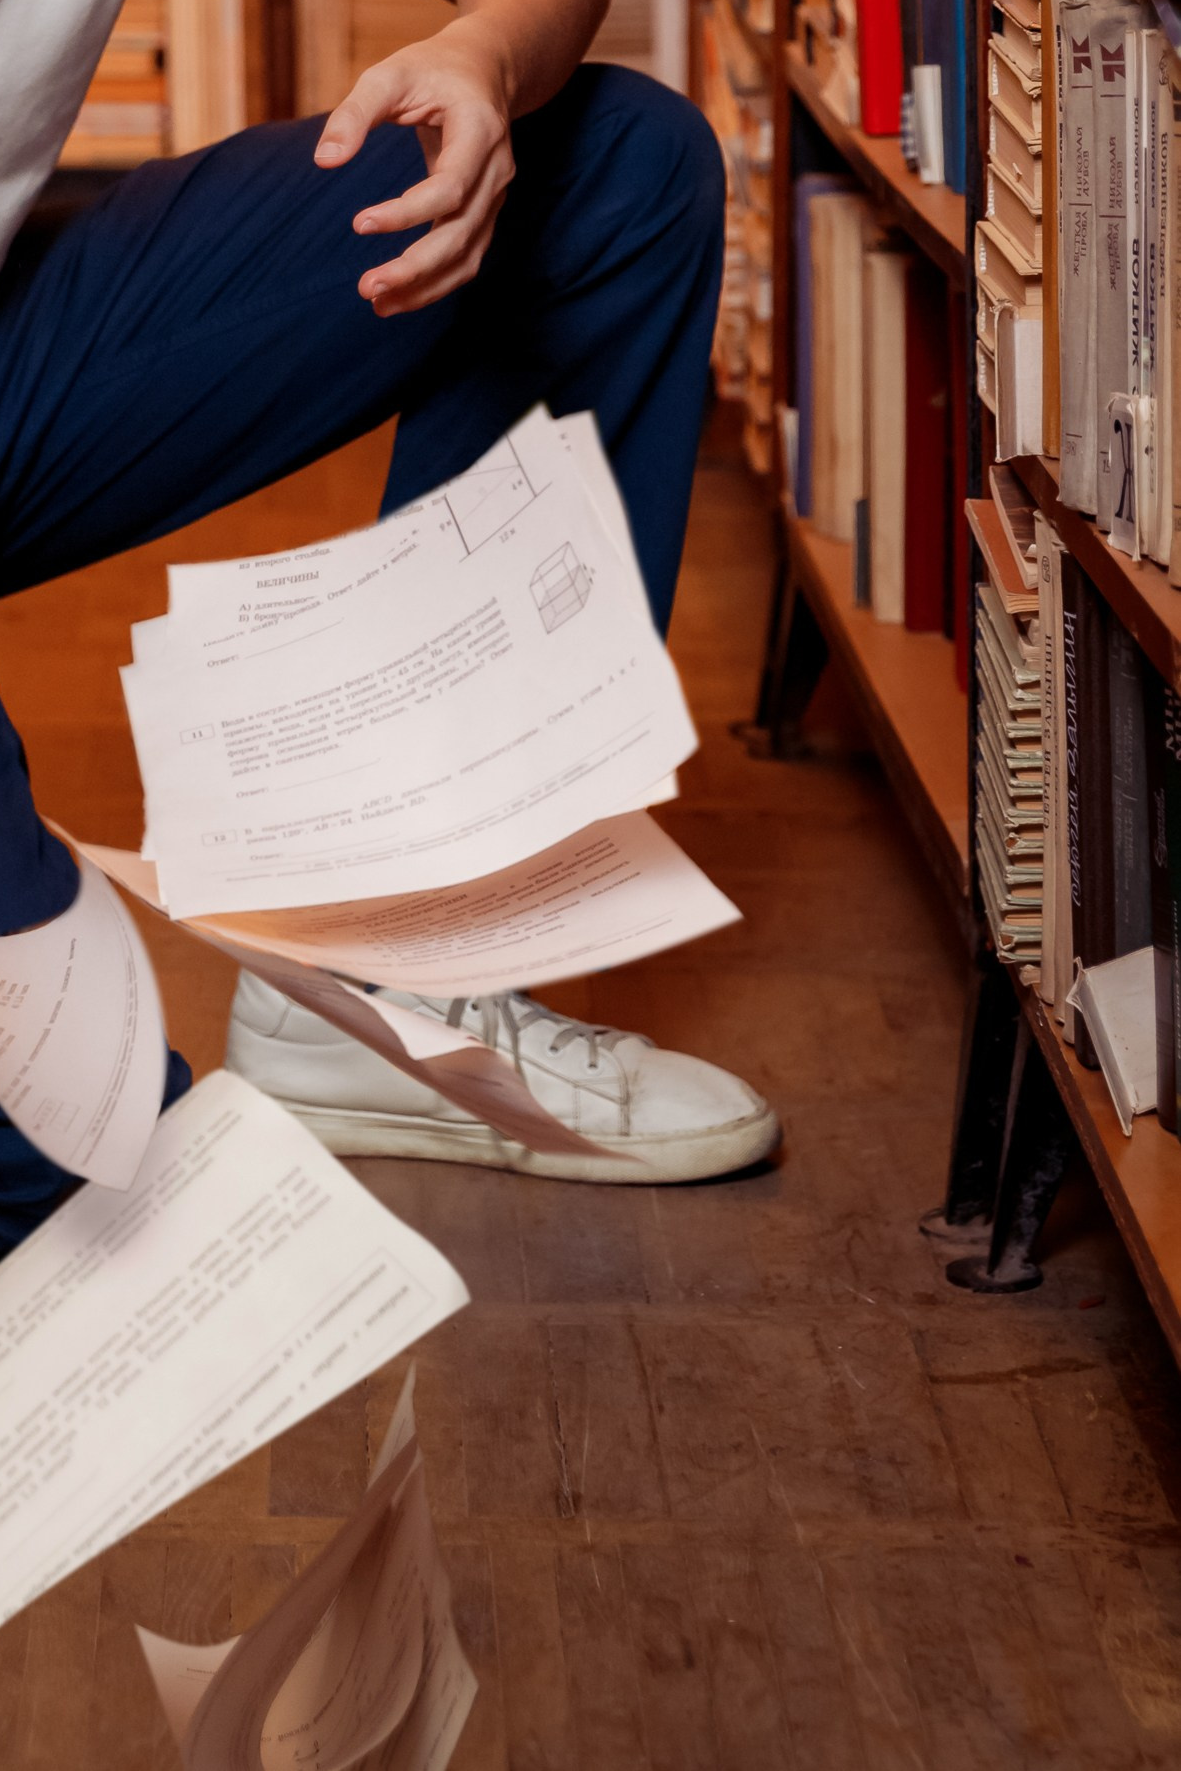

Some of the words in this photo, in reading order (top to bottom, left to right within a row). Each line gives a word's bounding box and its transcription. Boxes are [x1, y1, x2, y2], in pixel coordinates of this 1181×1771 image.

[1075, 127, 1083, 197] НИКОЛАЙ
[1082, 150, 1090, 197] ДУБОВ
[1108, 136, 1117, 208] НИКОЛАЙ
[1073, 212, 1082, 276] ЖЕСТКАЯ
[1080, 210, 1089, 258] ПРОБА
[1106, 222, 1117, 291] ЖЕСТКАЯ
[1132, 238, 1140, 367] ЖИТКОВ
[256, 570, 320, 589] ВЕЛИЧИНЫ
[191, 730, 203, 739] 11
[221, 716, 246, 728] Вода
[344, 671, 375, 689] форму
[377, 642, 429, 675] правильной
[272, 703, 324, 725] находится
[345, 683, 377, 701] уровне
[447, 629, 472, 649] каком
[475, 609, 501, 631] уровне
[1044, 633, 1052, 740] ЗАЛЫГИН
[227, 745, 260, 758] форму
[267, 724, 327, 748] правильной
[276, 735, 329, 756] основания
[1044, 748, 1052, 829] СЕРГЕЙ
